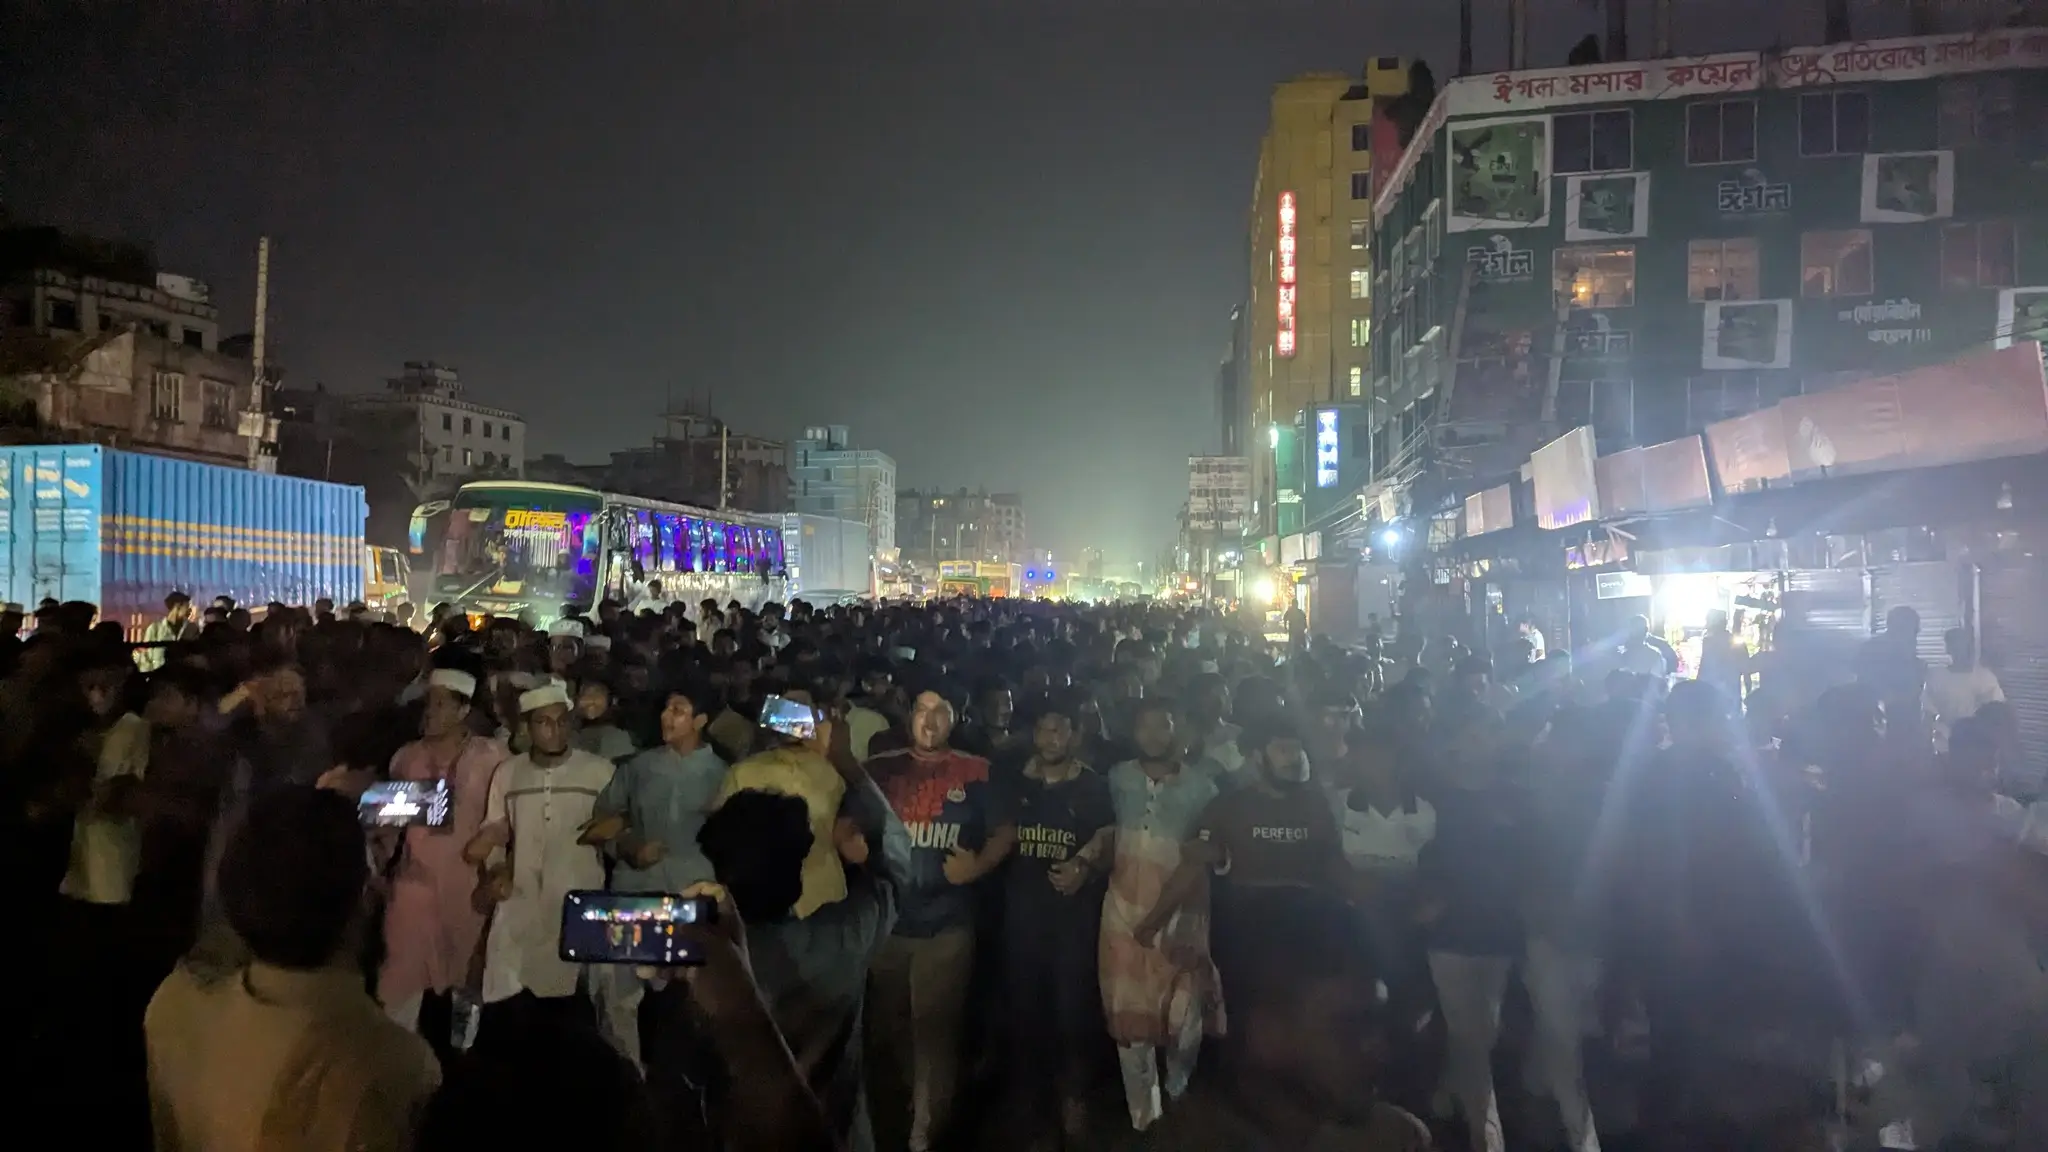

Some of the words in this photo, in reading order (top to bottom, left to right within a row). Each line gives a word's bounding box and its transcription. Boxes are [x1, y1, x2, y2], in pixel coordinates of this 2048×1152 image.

[1492, 74, 1558, 104] ঈগল
[1569, 71, 1643, 96] মশার
[1666, 61, 1754, 88] কয়েল
[1718, 181, 1791, 212] ঈগল
[1252, 826, 1308, 841] PERFECT
